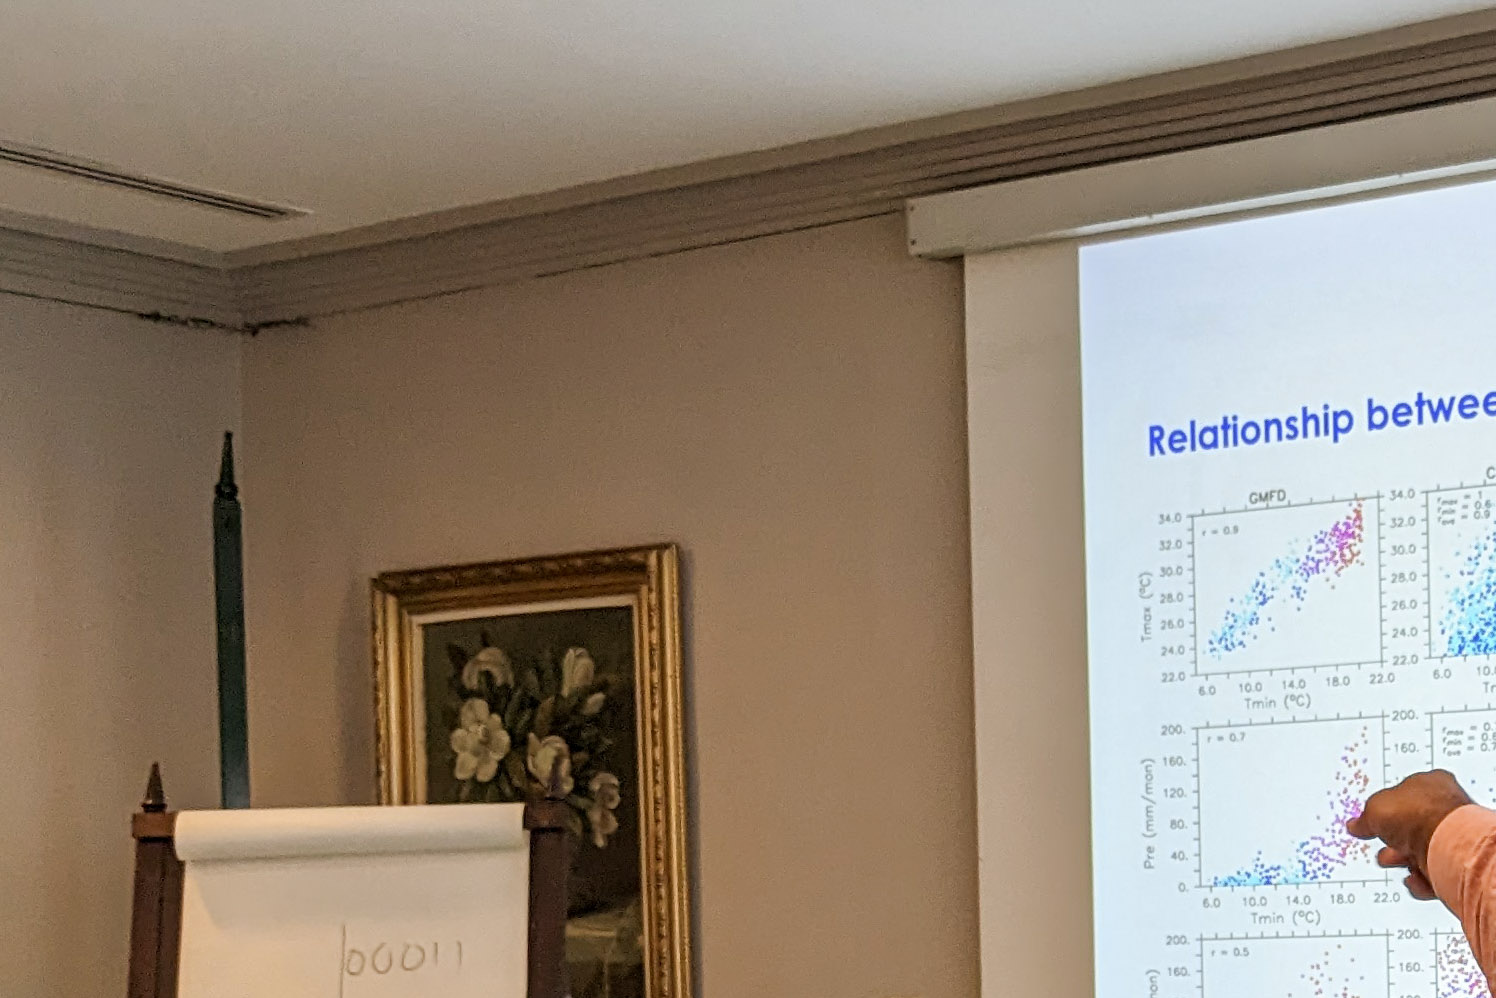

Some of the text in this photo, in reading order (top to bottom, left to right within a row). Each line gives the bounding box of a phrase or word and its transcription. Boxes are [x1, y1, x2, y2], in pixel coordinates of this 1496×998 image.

[1149, 403, 1354, 457] Relationship
[1249, 489, 1286, 504] GMFD
[1389, 489, 1415, 500] 34.0
[1158, 513, 1182, 524] 34.0
[1389, 517, 1415, 528] 32.0
[1159, 540, 1182, 550] 32.0
[1390, 544, 1416, 555] 30.0
[1160, 566, 1183, 577] 30.0
[1391, 571, 1417, 582] 28.0
[1160, 592, 1184, 603] 28.0
[1392, 599, 1417, 610] 26.0
[1141, 607, 1153, 642] Tmax
[1161, 618, 1185, 629] 26.0
[1392, 627, 1418, 638] 24.0
[1161, 645, 1185, 656] 24.0
[1392, 654, 1418, 666] 22.0
[1161, 672, 1186, 683] 22.0
[1433, 668, 1452, 679] 6.0
[1199, 672, 1395, 696] 6.0 10.0 14.0 18.0 22.0
[1244, 697, 1276, 710] Tmin
[1392, 710, 1418, 720] 200.
[1161, 725, 1186, 736] 200.
[1230, 732, 1246, 743] 0.7
[1394, 743, 1419, 753] 160.
[1163, 756, 1186, 767] 160.
[1164, 788, 1187, 798] 120.
[1141, 758, 1157, 869] Pre (mm/mon)
[1170, 819, 1187, 830] 80.
[1171, 851, 1188, 861] 40.
[1178, 882, 1188, 892] 0.
[1203, 892, 1400, 908] 6.0 10.0 14.0 18.0 22.0
[1251, 912, 1284, 924] Tmin
[1397, 929, 1423, 940] 200.
[1166, 935, 1190, 946] 200.
[1234, 947, 1250, 957] 0.5
[1167, 967, 1192, 977] 160.
[1399, 963, 1424, 973] 160.
